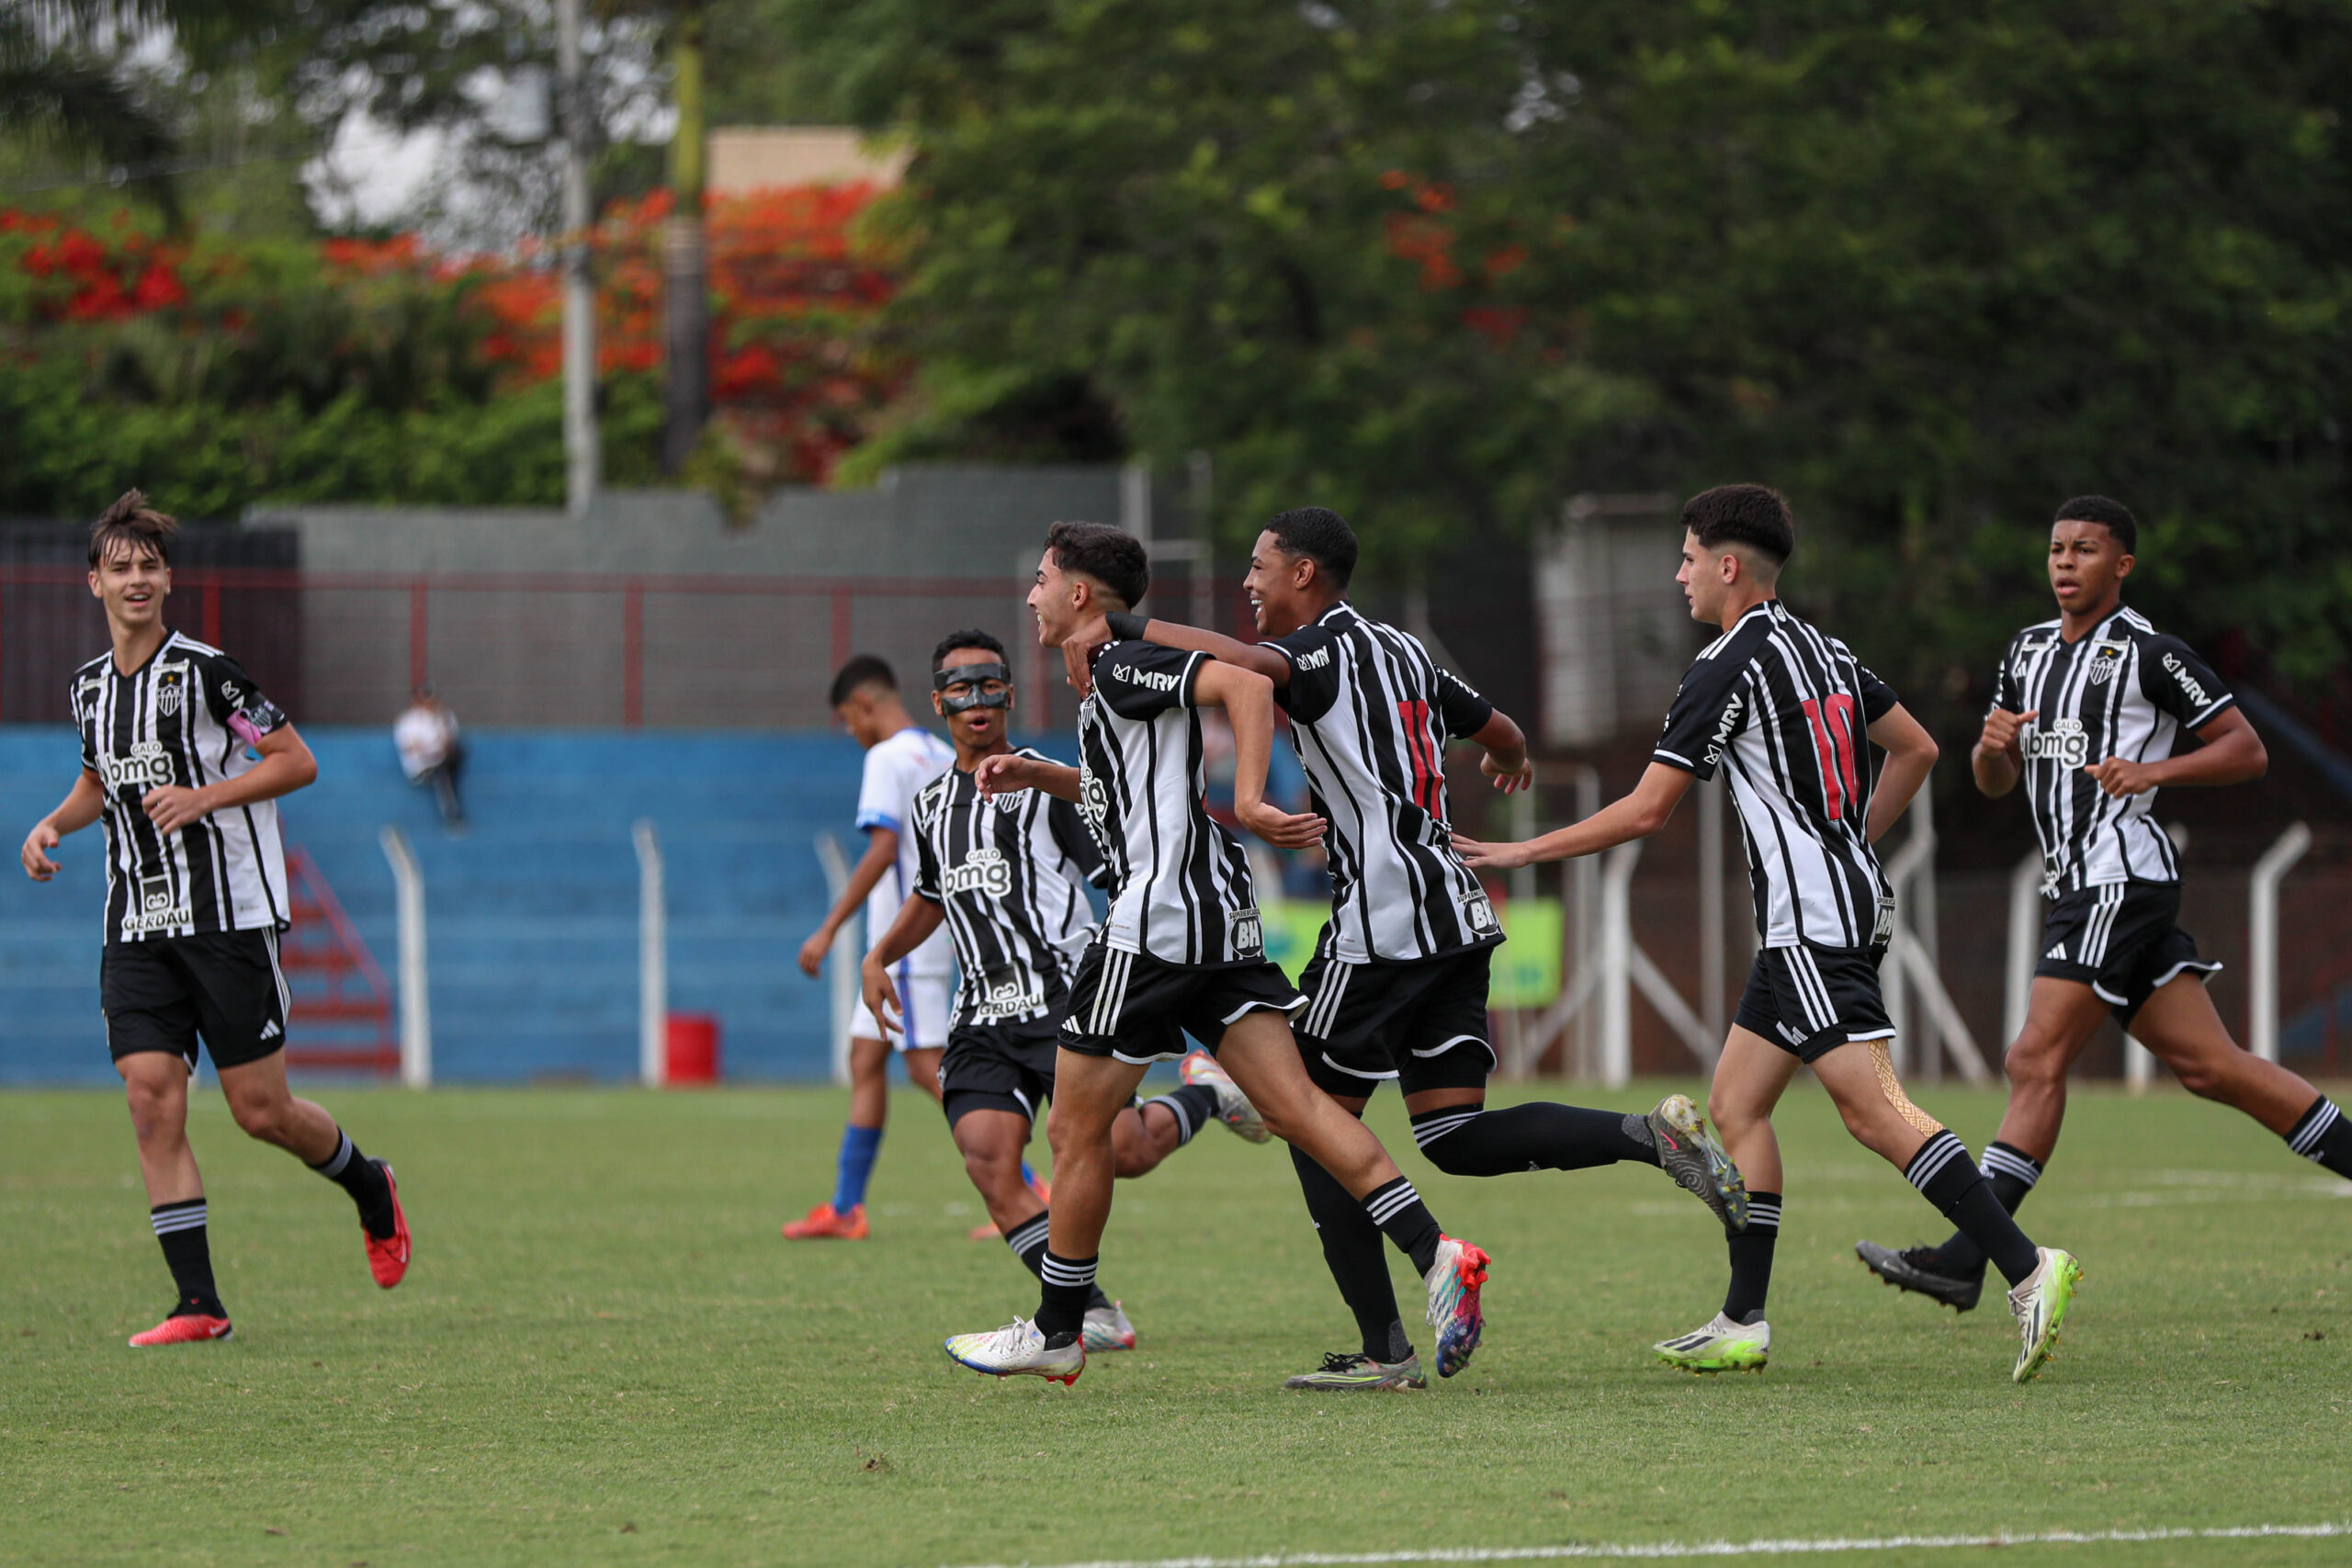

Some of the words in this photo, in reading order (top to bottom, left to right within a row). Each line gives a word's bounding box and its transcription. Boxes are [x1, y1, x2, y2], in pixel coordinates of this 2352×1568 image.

[1133, 668, 1181, 691] MRV
[2173, 668, 2212, 706] MRV
[1712, 693, 1743, 744] MRV
[2054, 721, 2080, 730] GALO
[132, 743, 161, 754] GALO
[1397, 699, 1442, 819] 11
[1801, 693, 1860, 820] 10
[2030, 735, 2085, 765] bmg
[109, 756, 173, 786] bmg
[968, 850, 1000, 862] GALO
[944, 863, 1008, 894] bmg
[124, 909, 189, 930] GERDAU
[1471, 899, 1496, 931] BH
[1238, 920, 1261, 949] BH
